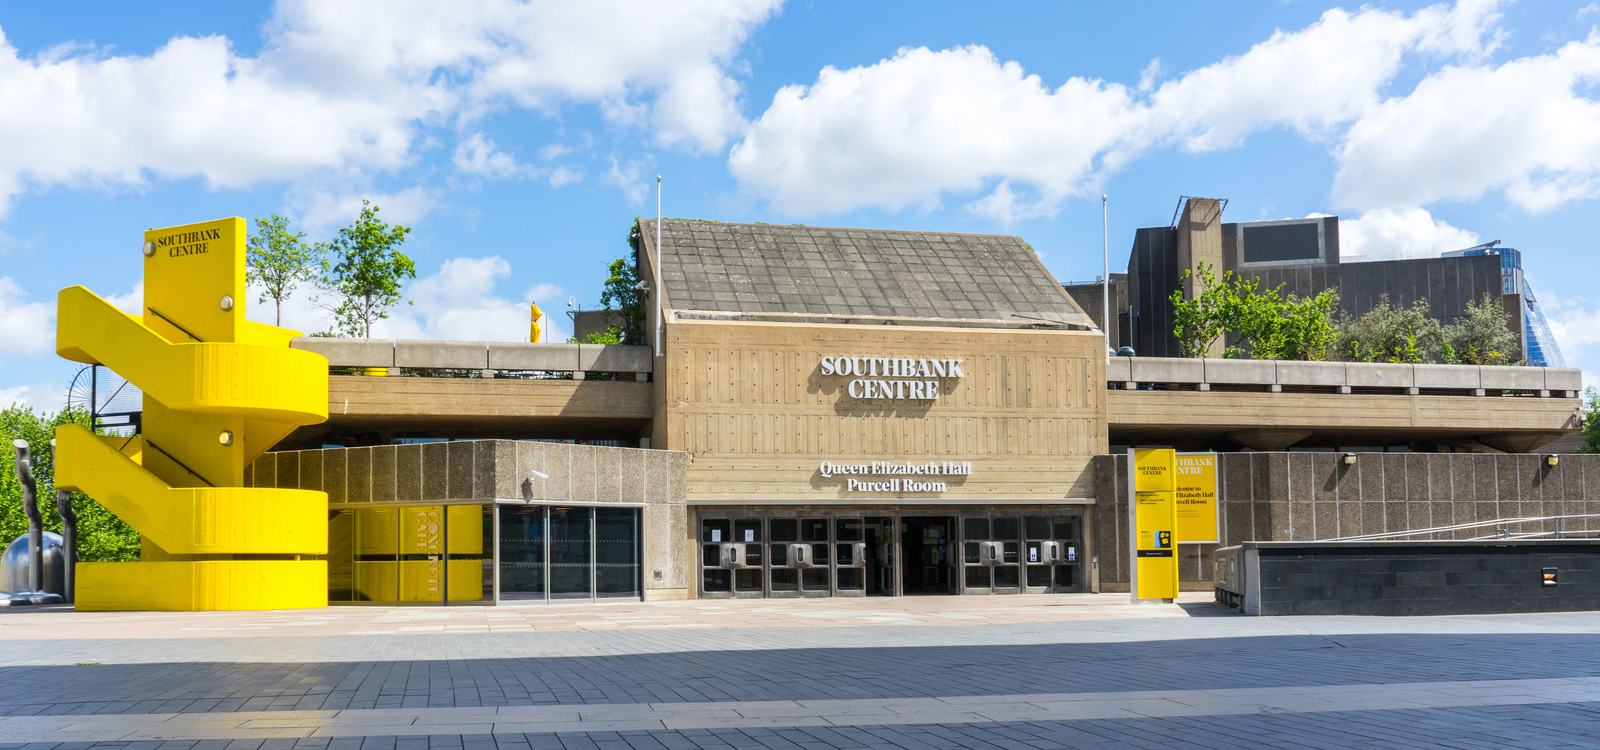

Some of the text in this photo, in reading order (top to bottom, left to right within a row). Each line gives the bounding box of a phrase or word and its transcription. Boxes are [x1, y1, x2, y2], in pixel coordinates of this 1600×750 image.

[158, 229, 220, 247] SOUTHBANK
[169, 242, 209, 258] CENTRE
[820, 356, 966, 378] SOUTHBANK
[848, 379, 940, 400] CENTRE
[820, 461, 972, 477] Queen Elizabeth Hall
[1176, 458, 1213, 466] THBANK
[1176, 466, 1203, 475] NTRE
[847, 478, 946, 493] Purcell Room
